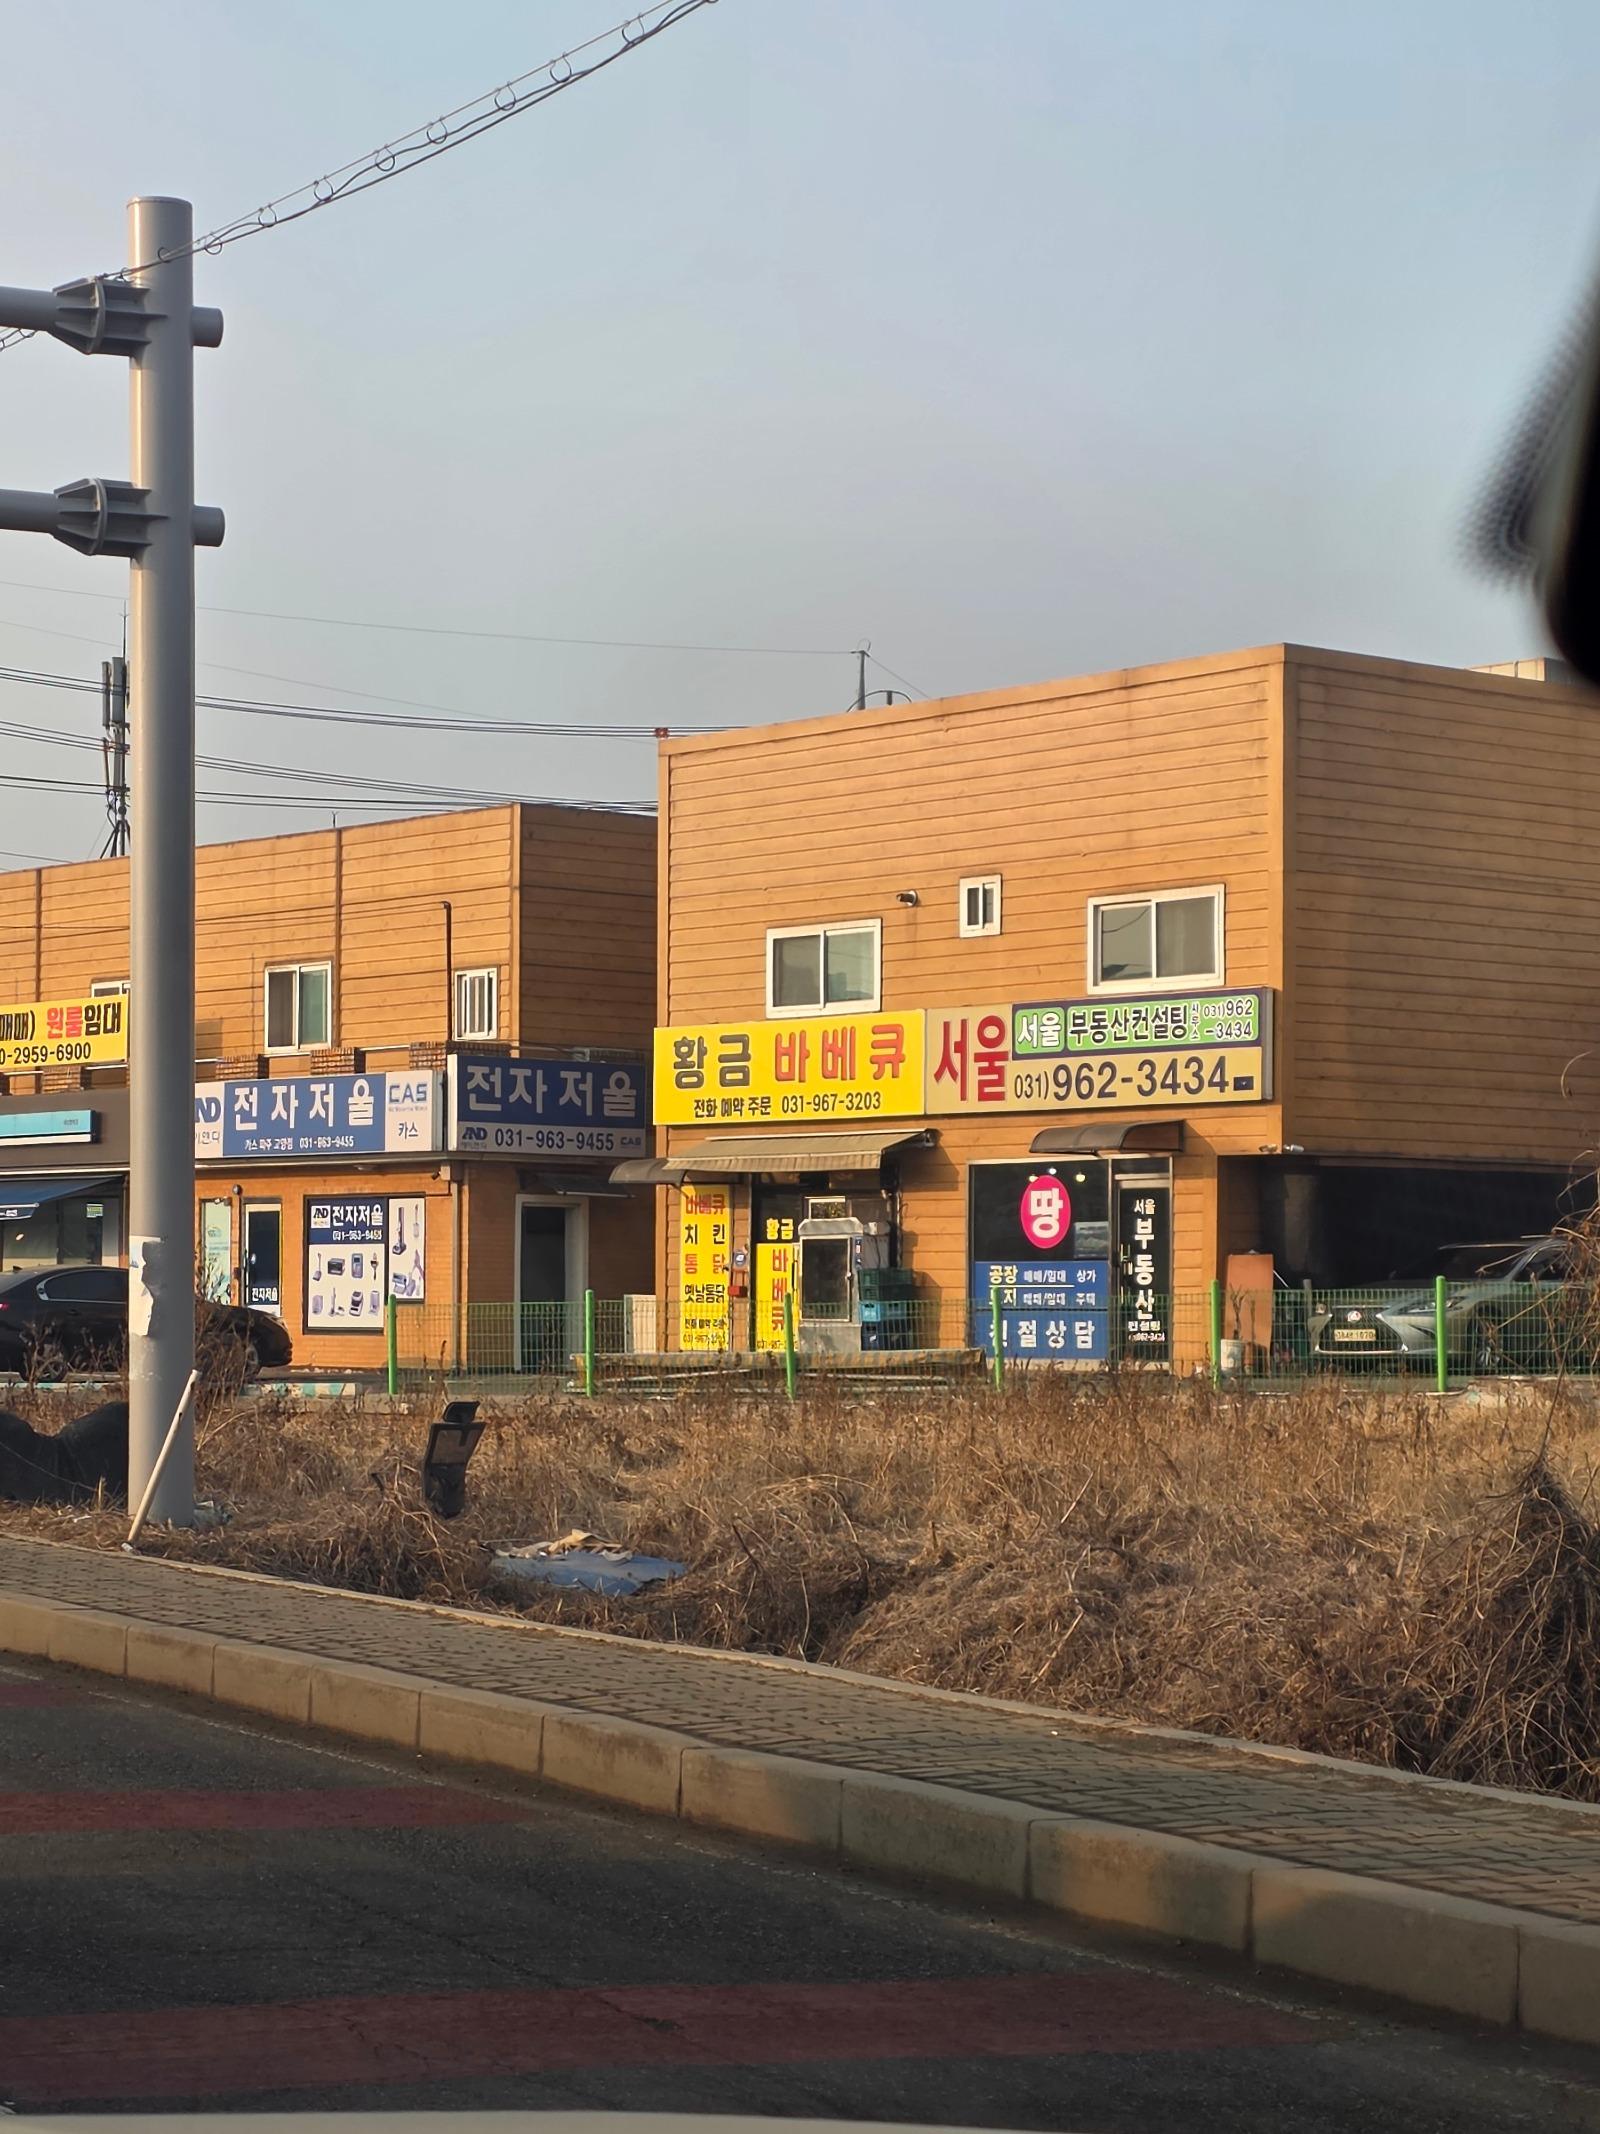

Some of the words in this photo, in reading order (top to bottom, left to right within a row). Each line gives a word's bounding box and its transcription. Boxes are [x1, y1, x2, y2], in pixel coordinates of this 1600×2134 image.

[1017, 1010, 1062, 1049] 서울
[1069, 1003, 1188, 1044] 부동산컨설팅
[673, 1033, 751, 1089] 황금
[775, 1023, 905, 1083] 바베큐
[934, 1015, 1009, 1102] 서울
[389, 1083, 427, 1103] CAS
[467, 1065, 637, 1118] 전자저울
[234, 1078, 374, 1131] 전자저울
[694, 1098, 717, 1119] 전화
[721, 1097, 744, 1118] 예약
[748, 1095, 771, 1116] 주문
[781, 1091, 881, 1114] 031-967-3203
[398, 1121, 419, 1140] 카스
[495, 1128, 614, 1151] 031-963-9455
[332, 1204, 383, 1227] 전자저울
[685, 1193, 726, 1216] 바베큐
[1030, 1187, 1063, 1239] 땅
[1134, 1198, 1156, 1215] 서울
[989, 1265, 1018, 1284] 공장
[1076, 1269, 1096, 1284] 상가
[1134, 1218, 1155, 1320] 부동산
[990, 1288, 1017, 1307] 지
[1075, 1292, 1096, 1306] 주택
